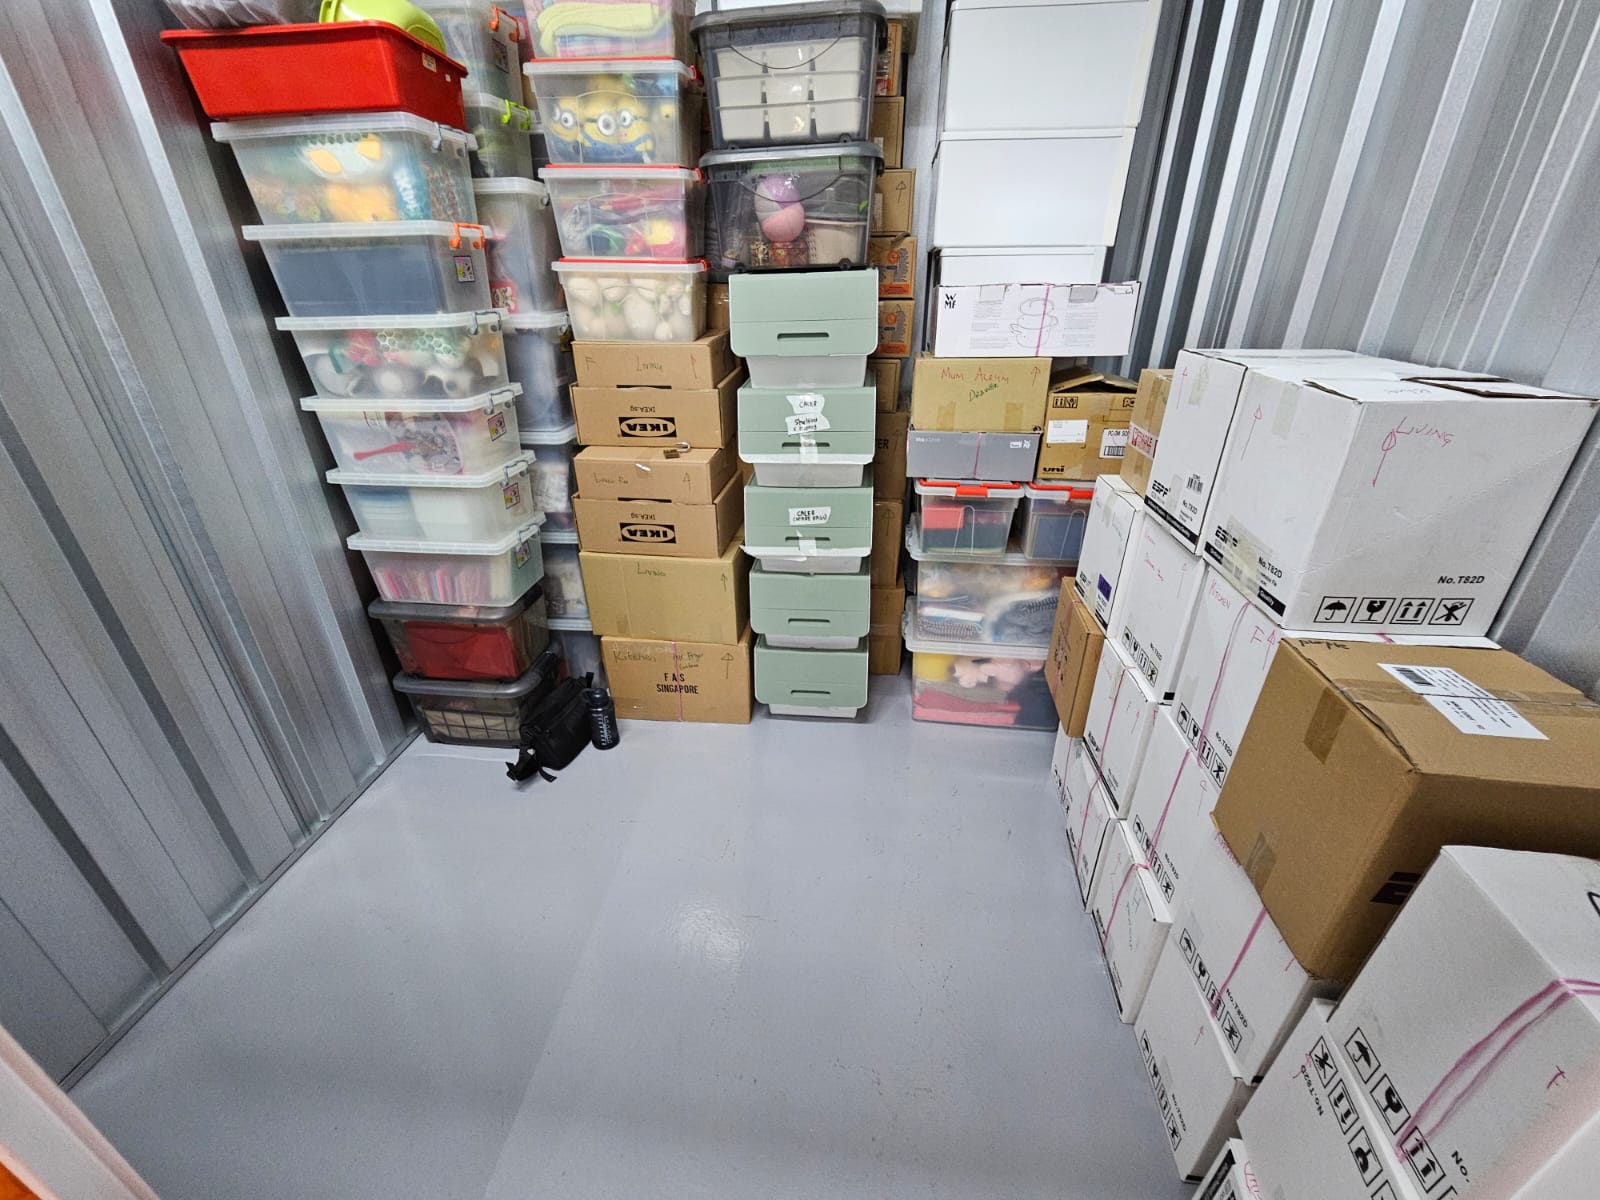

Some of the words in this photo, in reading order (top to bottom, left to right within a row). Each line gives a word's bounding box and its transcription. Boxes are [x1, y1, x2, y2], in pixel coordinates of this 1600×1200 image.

[626, 422, 669, 432] IKEA
[1042, 465, 1065, 473] uni
[626, 527, 669, 538] IKEA
[1258, 556, 1283, 579] No.T82D
[1437, 575, 1486, 585] No.T82D
[656, 683, 699, 694] SINGAPORE
[1215, 731, 1233, 757] No.T82D
[1226, 988, 1248, 1028] No.T82D
[1301, 1064, 1325, 1117] No.T82D
